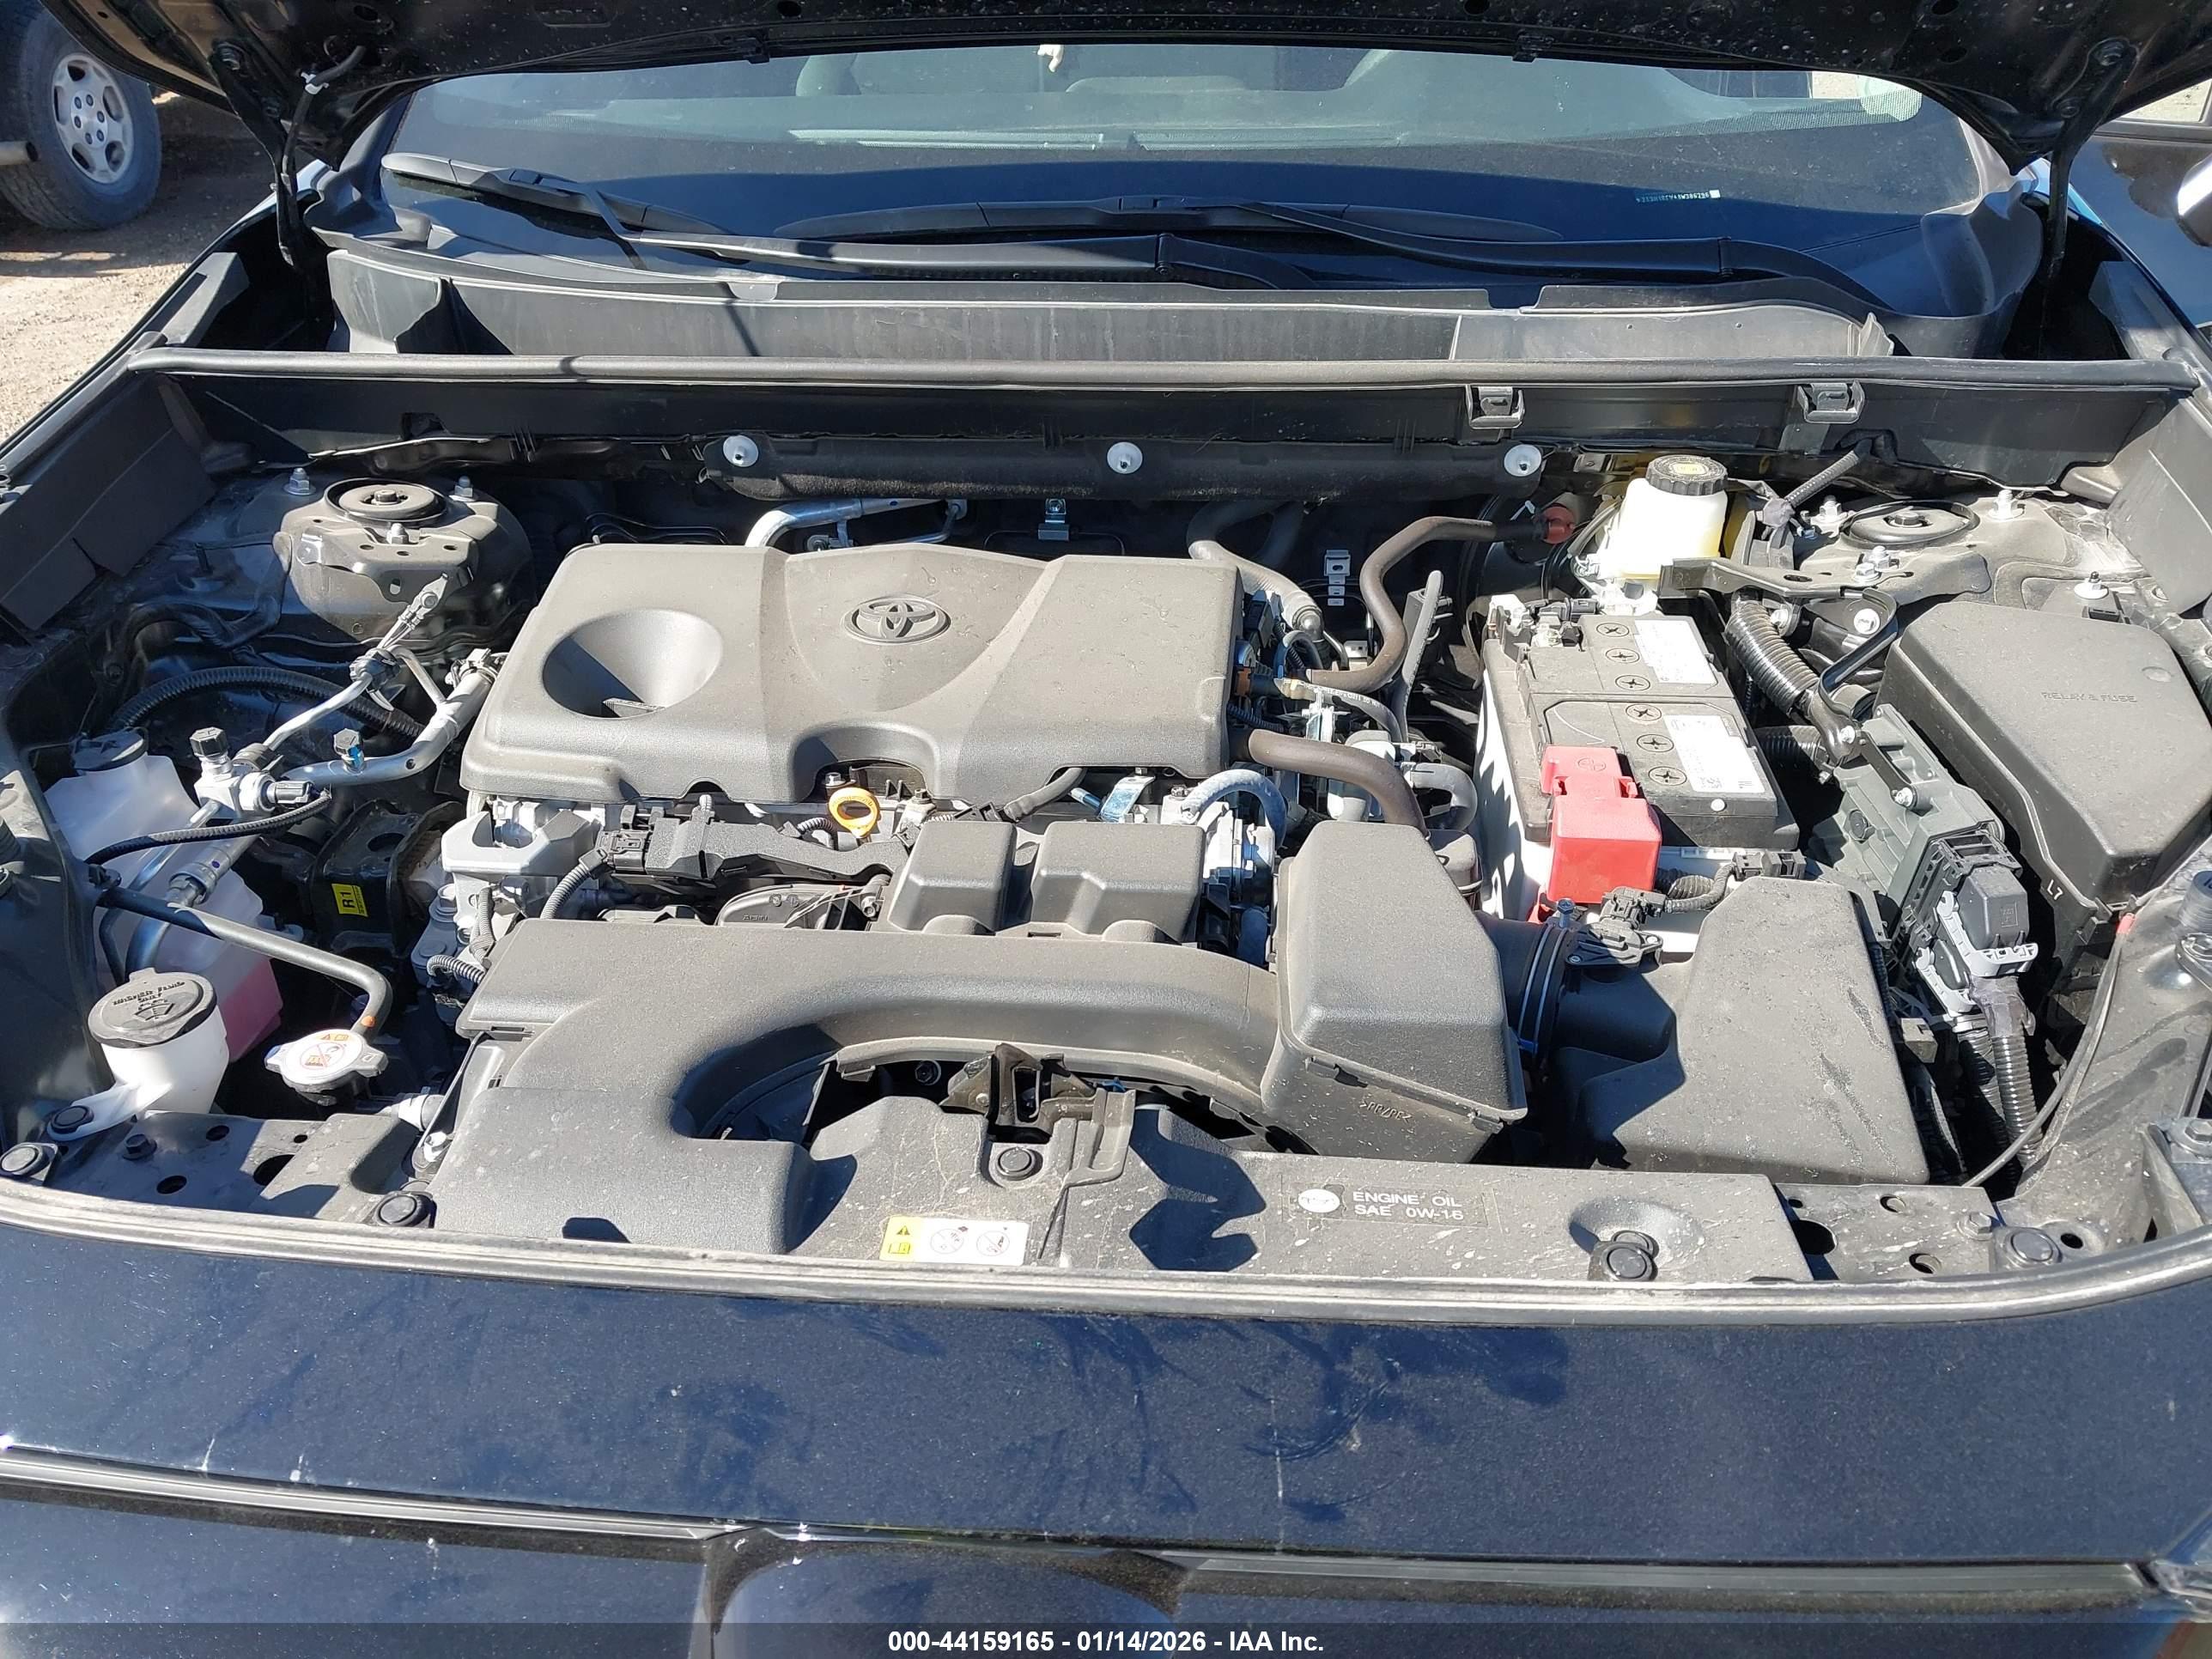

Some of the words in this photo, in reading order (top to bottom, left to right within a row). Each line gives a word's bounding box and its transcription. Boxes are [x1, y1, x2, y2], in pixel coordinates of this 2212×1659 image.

[2100, 695, 2138, 703] FUSE
[1352, 1190, 1420, 1206] ENGINE
[1431, 1195, 1463, 1208] OIL
[1353, 1204, 1393, 1218] SAE
